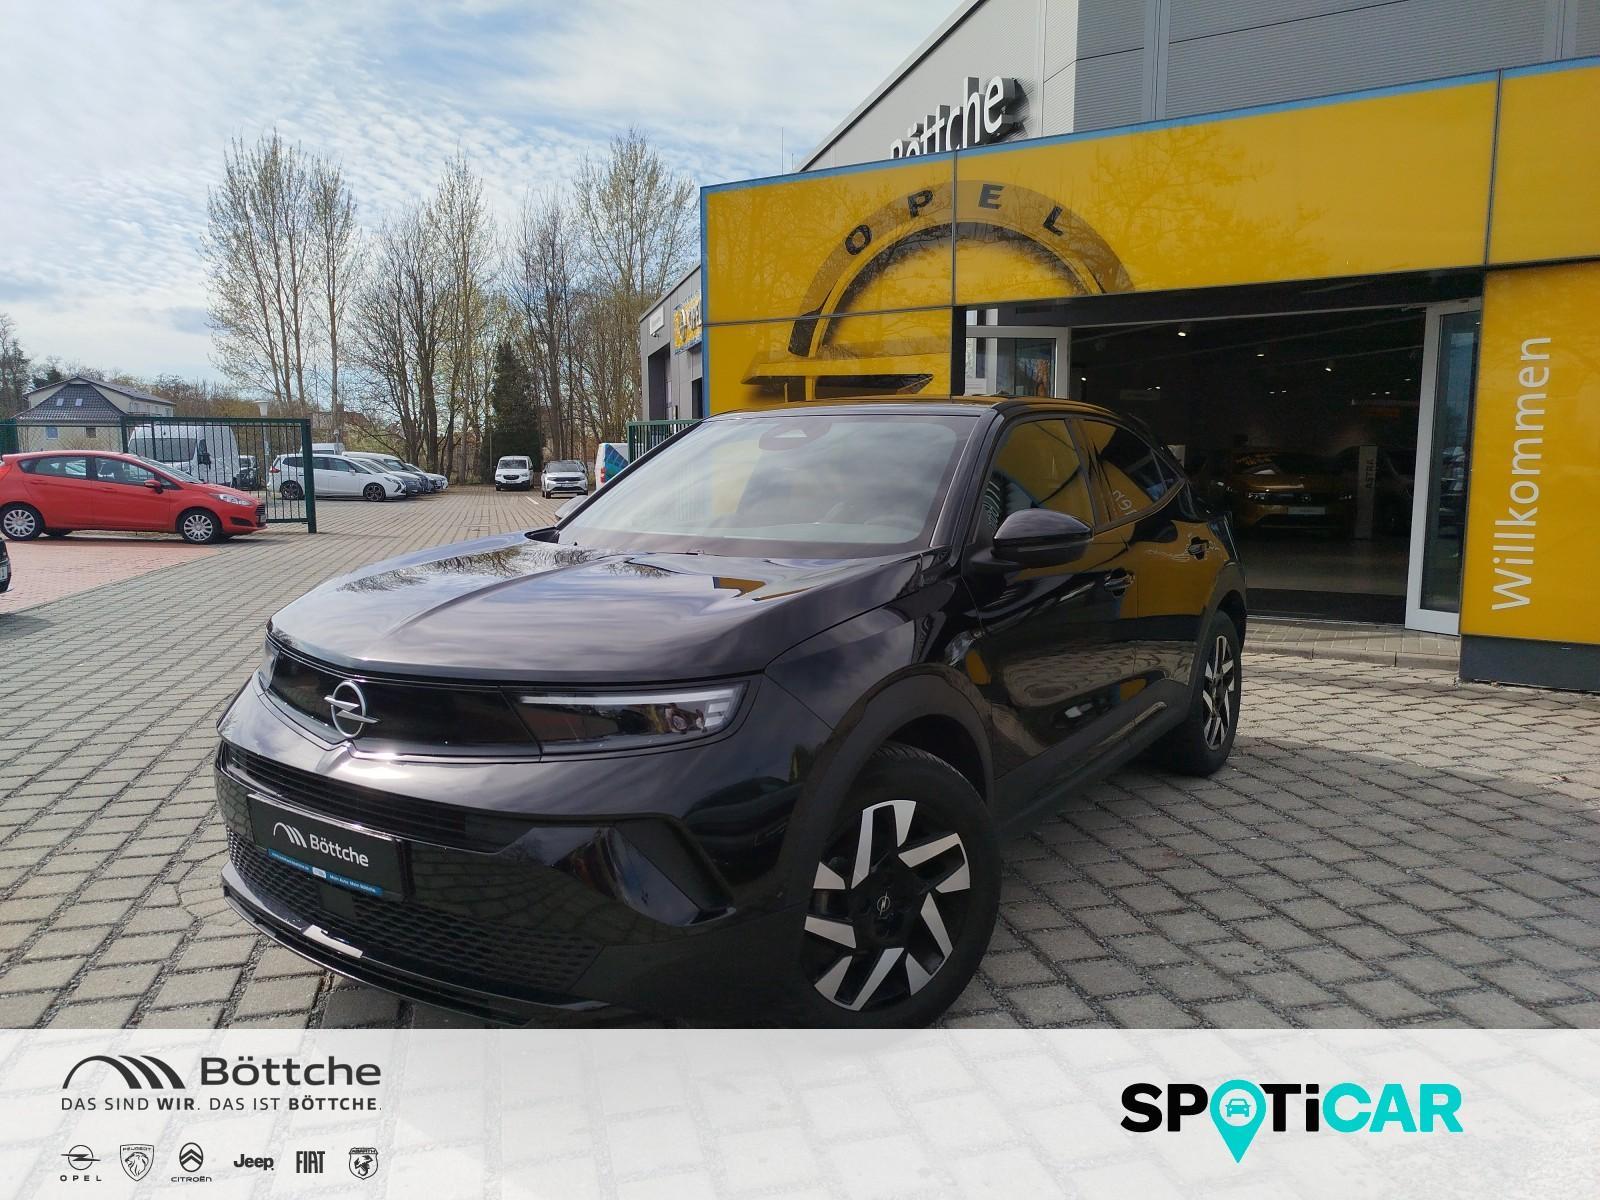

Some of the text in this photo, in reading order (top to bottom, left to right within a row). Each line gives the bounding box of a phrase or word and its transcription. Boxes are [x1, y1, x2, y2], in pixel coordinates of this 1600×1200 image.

[844, 184, 1063, 256] OPEL
[1491, 336, 1552, 611] Willkommen
[309, 833, 369, 867] Böttche
